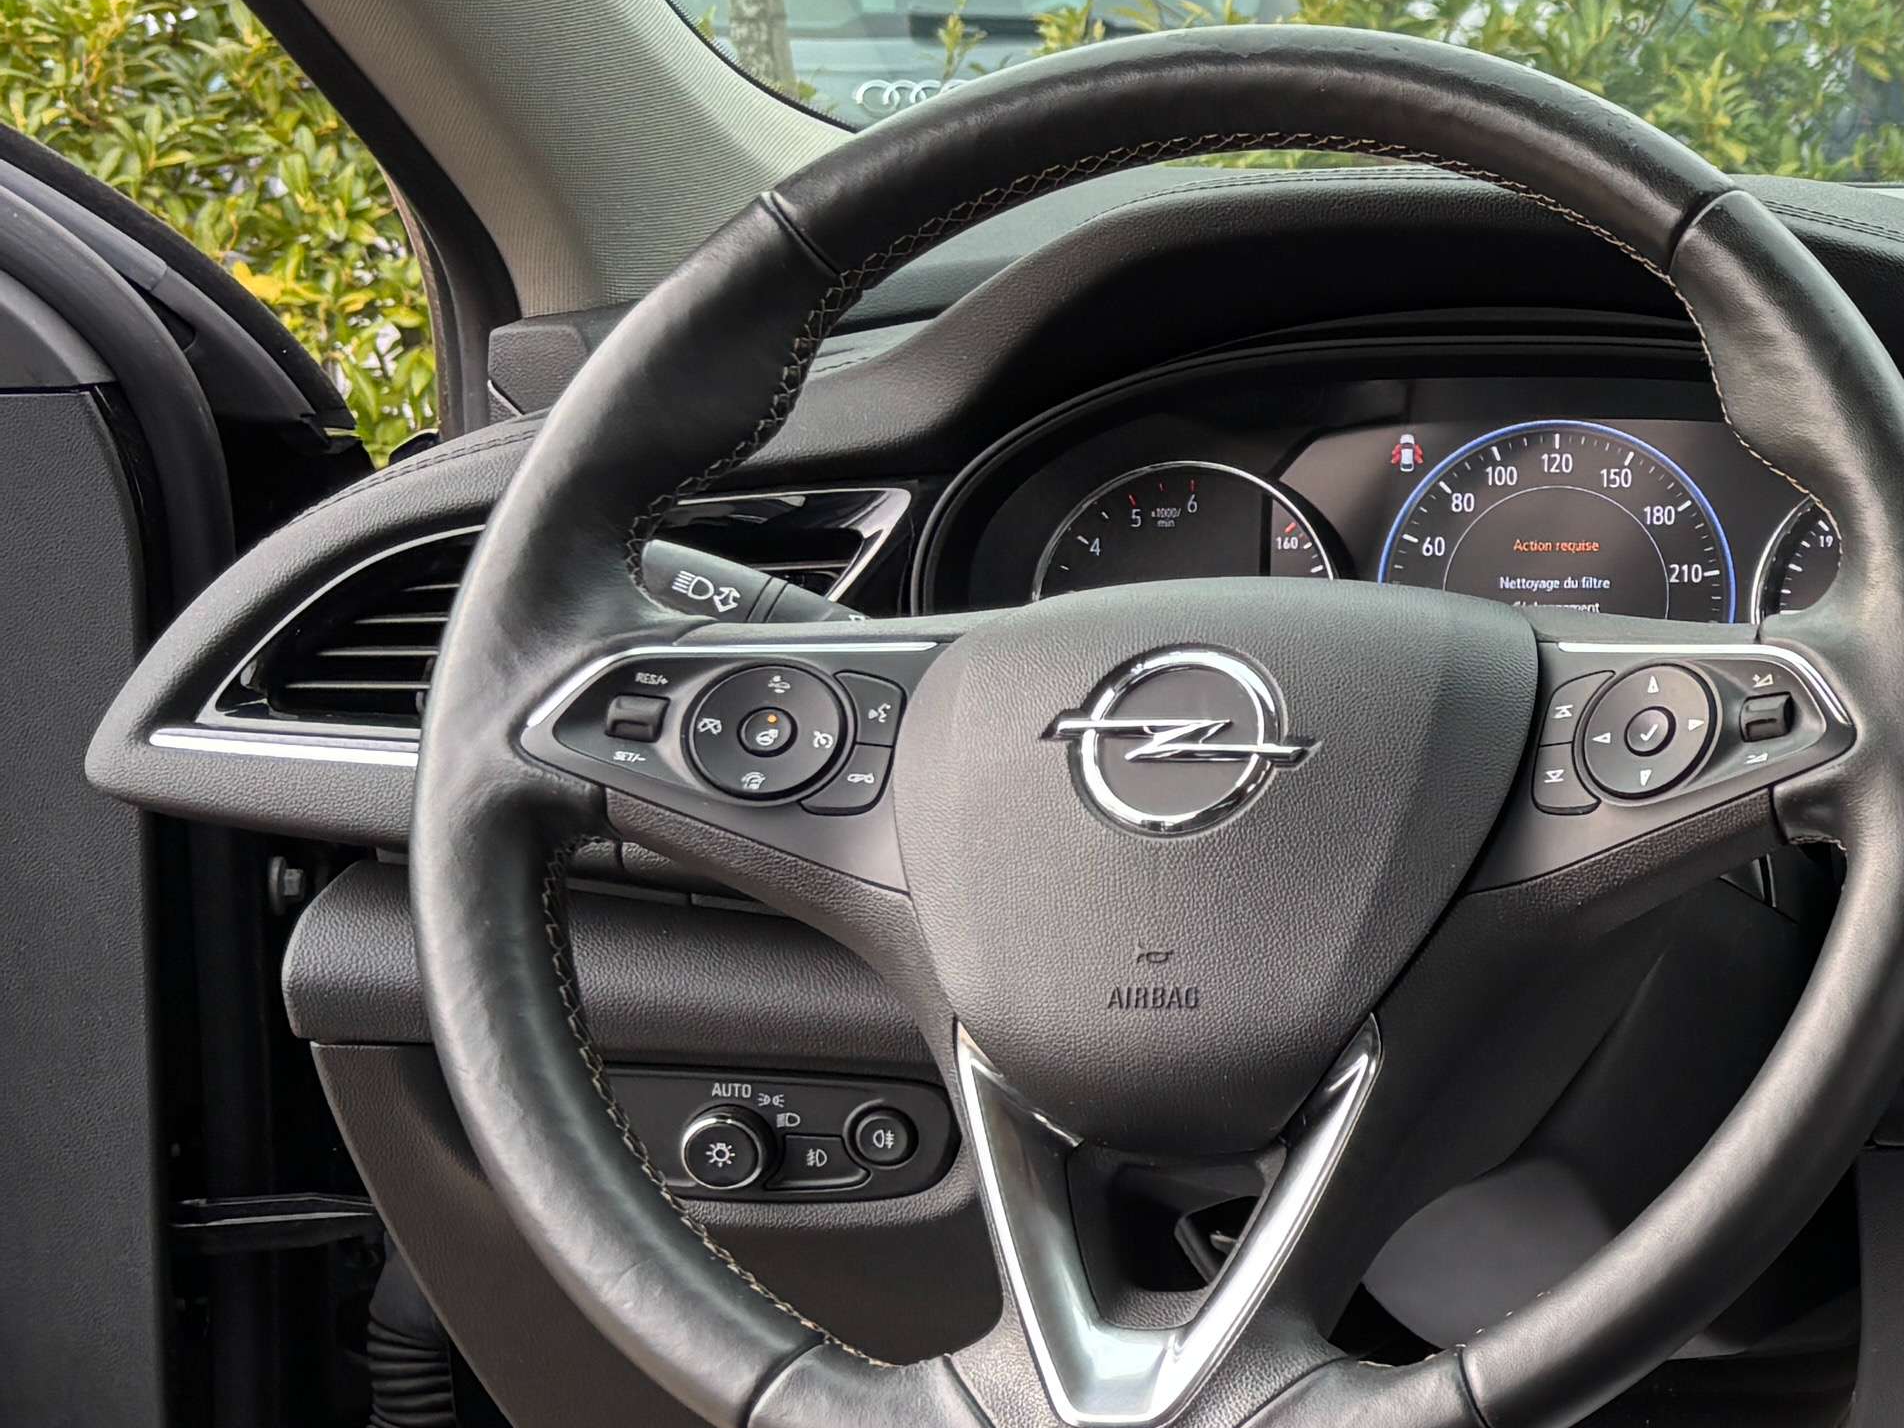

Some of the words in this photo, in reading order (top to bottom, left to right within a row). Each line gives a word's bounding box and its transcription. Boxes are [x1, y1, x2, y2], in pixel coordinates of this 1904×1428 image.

[1541, 453, 1573, 473] 120
[1486, 466, 1518, 486] 100
[1600, 468, 1632, 488] 150
[1187, 494, 1198, 513] 6
[1451, 492, 1475, 513] 80
[1130, 508, 1142, 528] 5
[1643, 505, 1675, 526] 180
[1089, 538, 1101, 556] 4
[1276, 536, 1299, 550] 160
[1422, 536, 1445, 556] 60
[1513, 538, 1552, 552] Action
[1556, 540, 1600, 553] requise
[1669, 563, 1702, 584] 210
[1500, 576, 1560, 592] Nettoyage
[1563, 576, 1578, 589] du
[1581, 576, 1611, 589] filtre
[1108, 986, 1200, 1009] AIRBAG
[711, 1082, 752, 1098] AUTO
